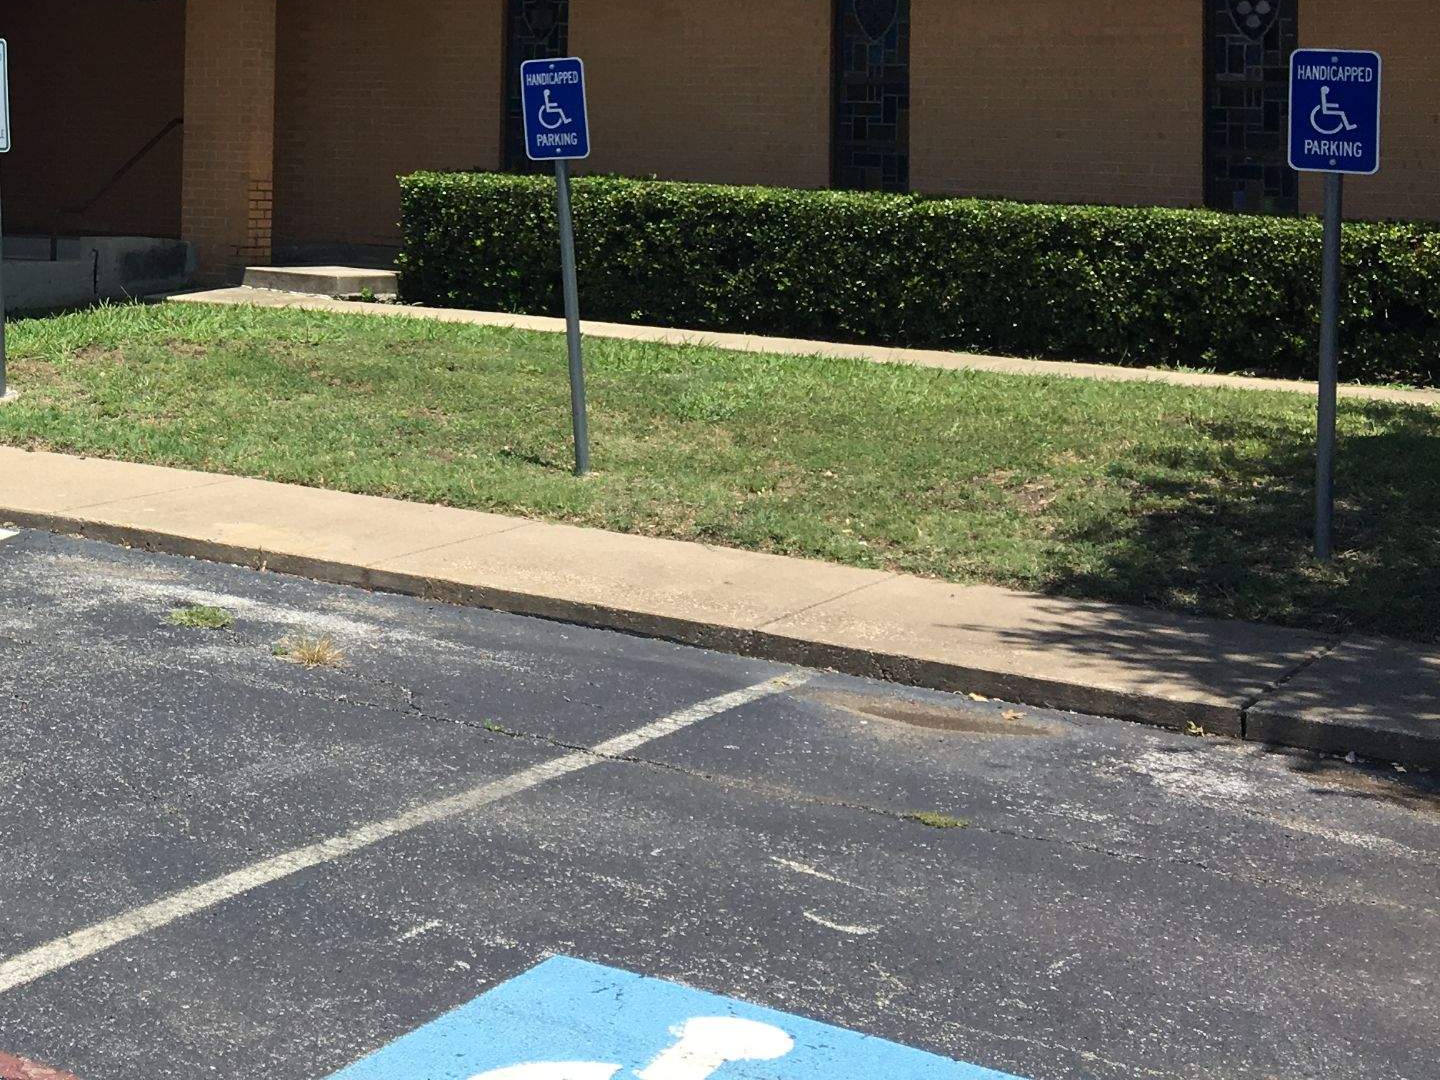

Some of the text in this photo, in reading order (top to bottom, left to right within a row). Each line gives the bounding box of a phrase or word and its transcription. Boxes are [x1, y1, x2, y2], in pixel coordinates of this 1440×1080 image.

[526, 71, 579, 86] HANDICAPPED
[1297, 65, 1373, 83] HANDICAPPED
[536, 132, 578, 147] PARKING
[1304, 139, 1363, 158] PARKING
